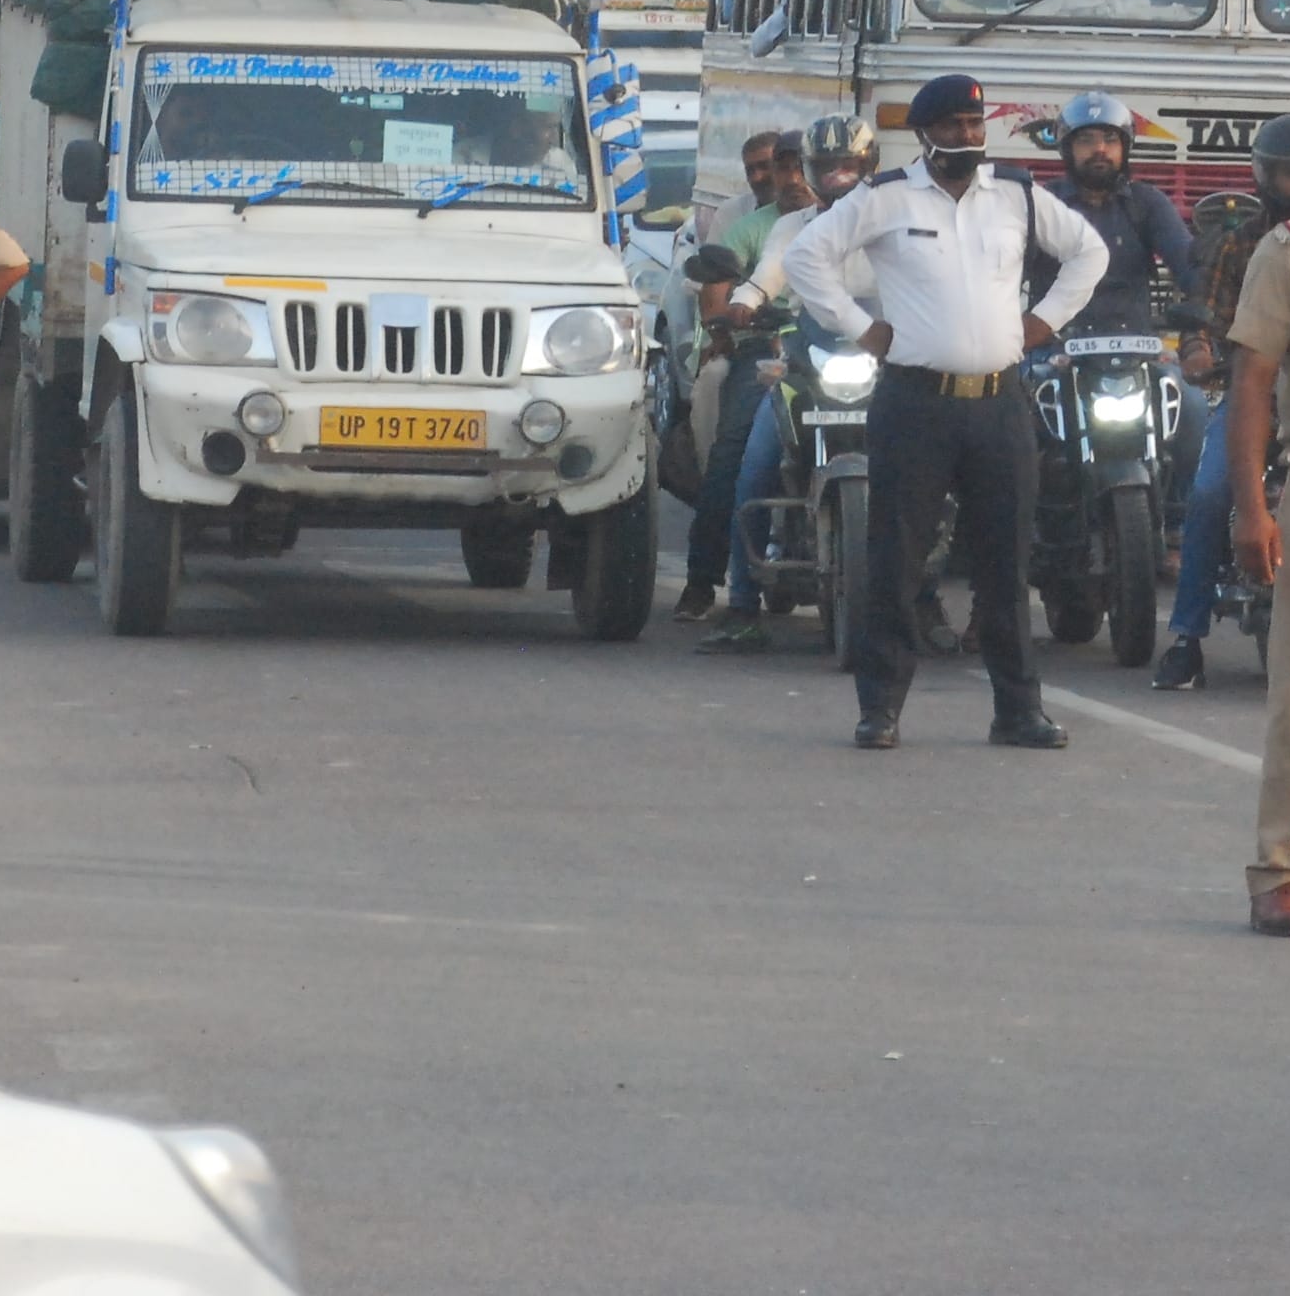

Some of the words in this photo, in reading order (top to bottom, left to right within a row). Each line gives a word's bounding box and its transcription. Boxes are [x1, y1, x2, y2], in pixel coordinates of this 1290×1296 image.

[1186, 119, 1258, 146] TAT
[339, 415, 366, 439] UP
[425, 417, 480, 442] 3740
